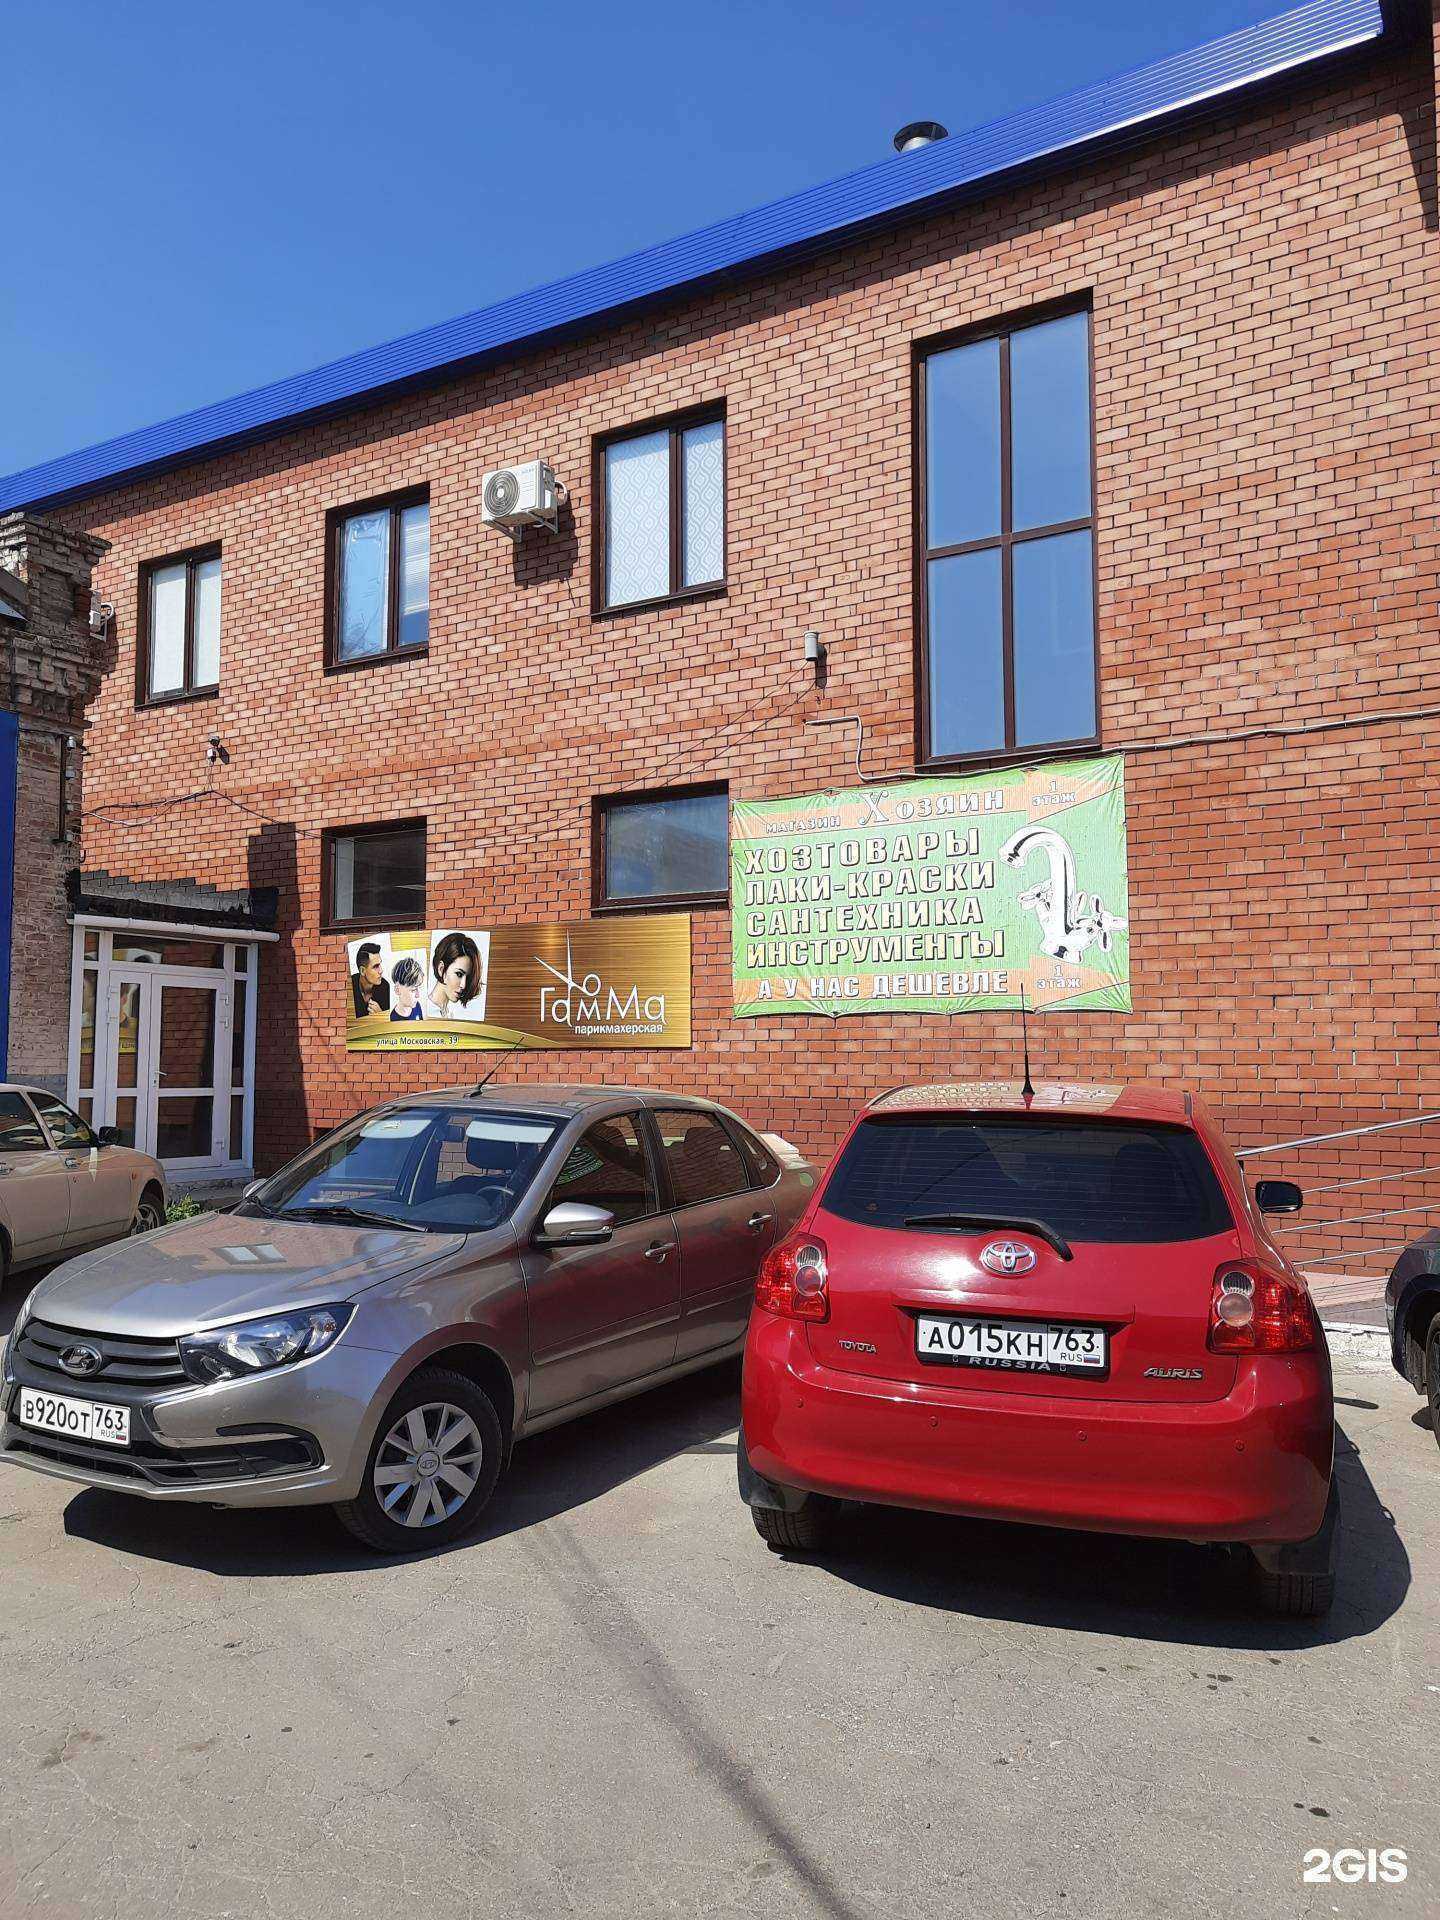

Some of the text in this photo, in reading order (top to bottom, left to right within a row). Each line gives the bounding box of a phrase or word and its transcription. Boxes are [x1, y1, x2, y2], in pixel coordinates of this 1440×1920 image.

[1049, 780, 1057, 793] 1
[1032, 792, 1076, 807] этаж
[765, 815, 841, 834] МАГАЗИН
[743, 828, 980, 875] ХОЗТОВАРЫ
[744, 861, 995, 907] ЛАКИ-КРАСКИ
[746, 897, 984, 937] САНТЕХНИКА
[746, 930, 1005, 969] ИНСТРУМЕНТЫ
[1054, 965, 1063, 977] 1
[758, 971, 1009, 1000] А У НАС ДЕШЕВЛЕ
[1036, 978, 1081, 989] этаж
[574, 1022, 664, 1036] парикмахерская
[376, 1037, 398, 1047] улица
[838, 1339, 877, 1353] TOYOTA
[1050, 1328, 1095, 1353] 763
[968, 1355, 1051, 1371] RUSSIA
[1060, 1352, 1083, 1363] RUS
[1143, 1367, 1203, 1379] AURIS
[94, 1407, 124, 1430] 763
[100, 1429, 116, 1439] RUS
